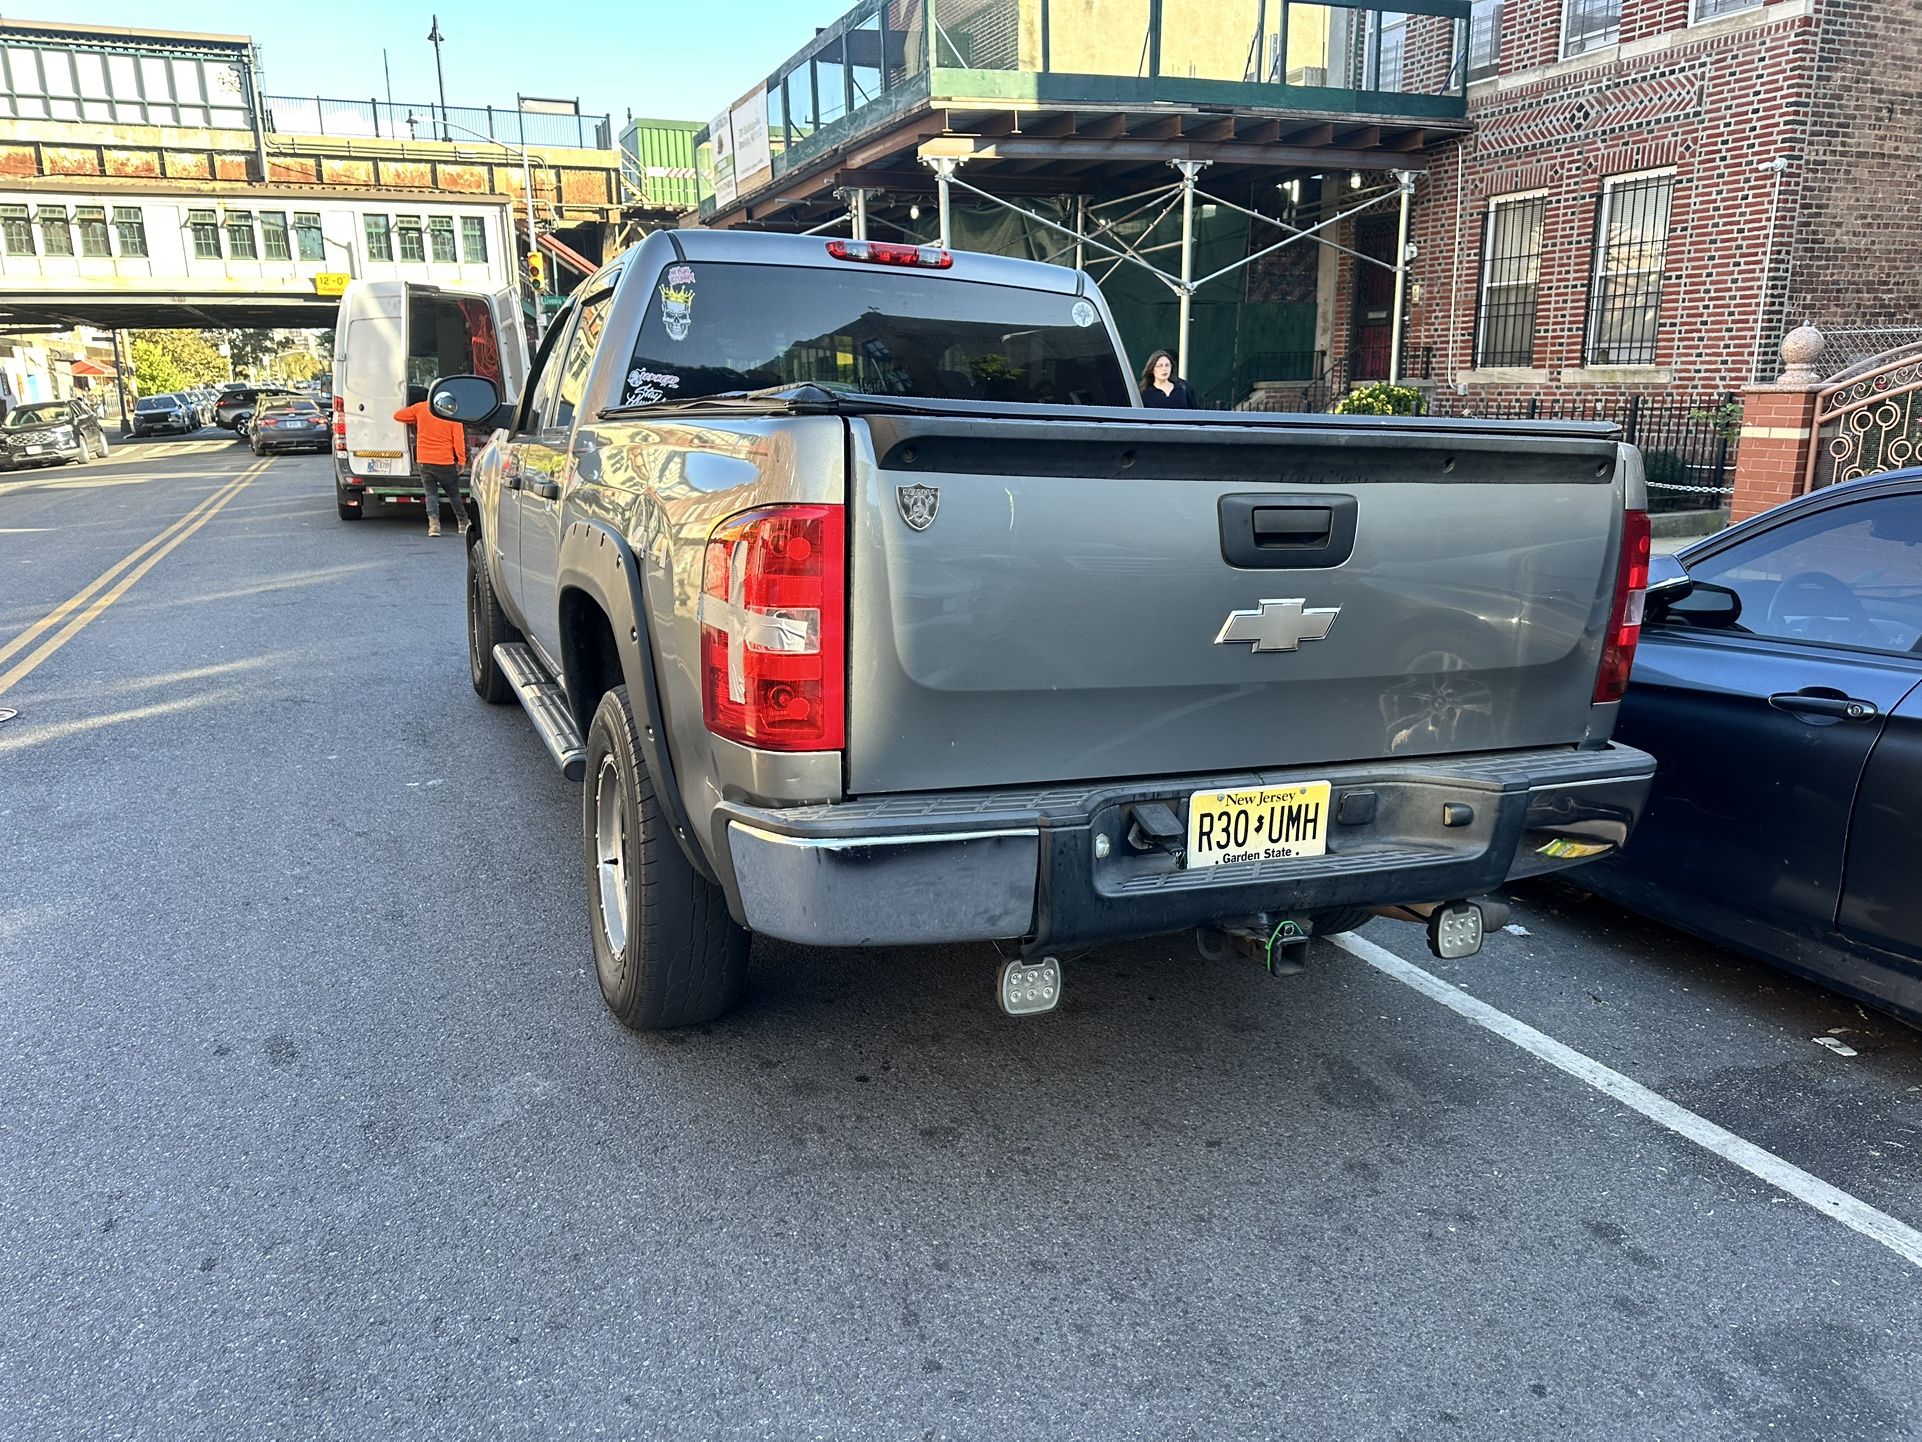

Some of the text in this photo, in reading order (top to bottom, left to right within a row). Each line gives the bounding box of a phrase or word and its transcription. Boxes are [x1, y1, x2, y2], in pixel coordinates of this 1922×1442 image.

[634, 383, 664, 403] Stay
[1226, 791, 1296, 807] New Jersey
[1222, 848, 1292, 864] Garden State
